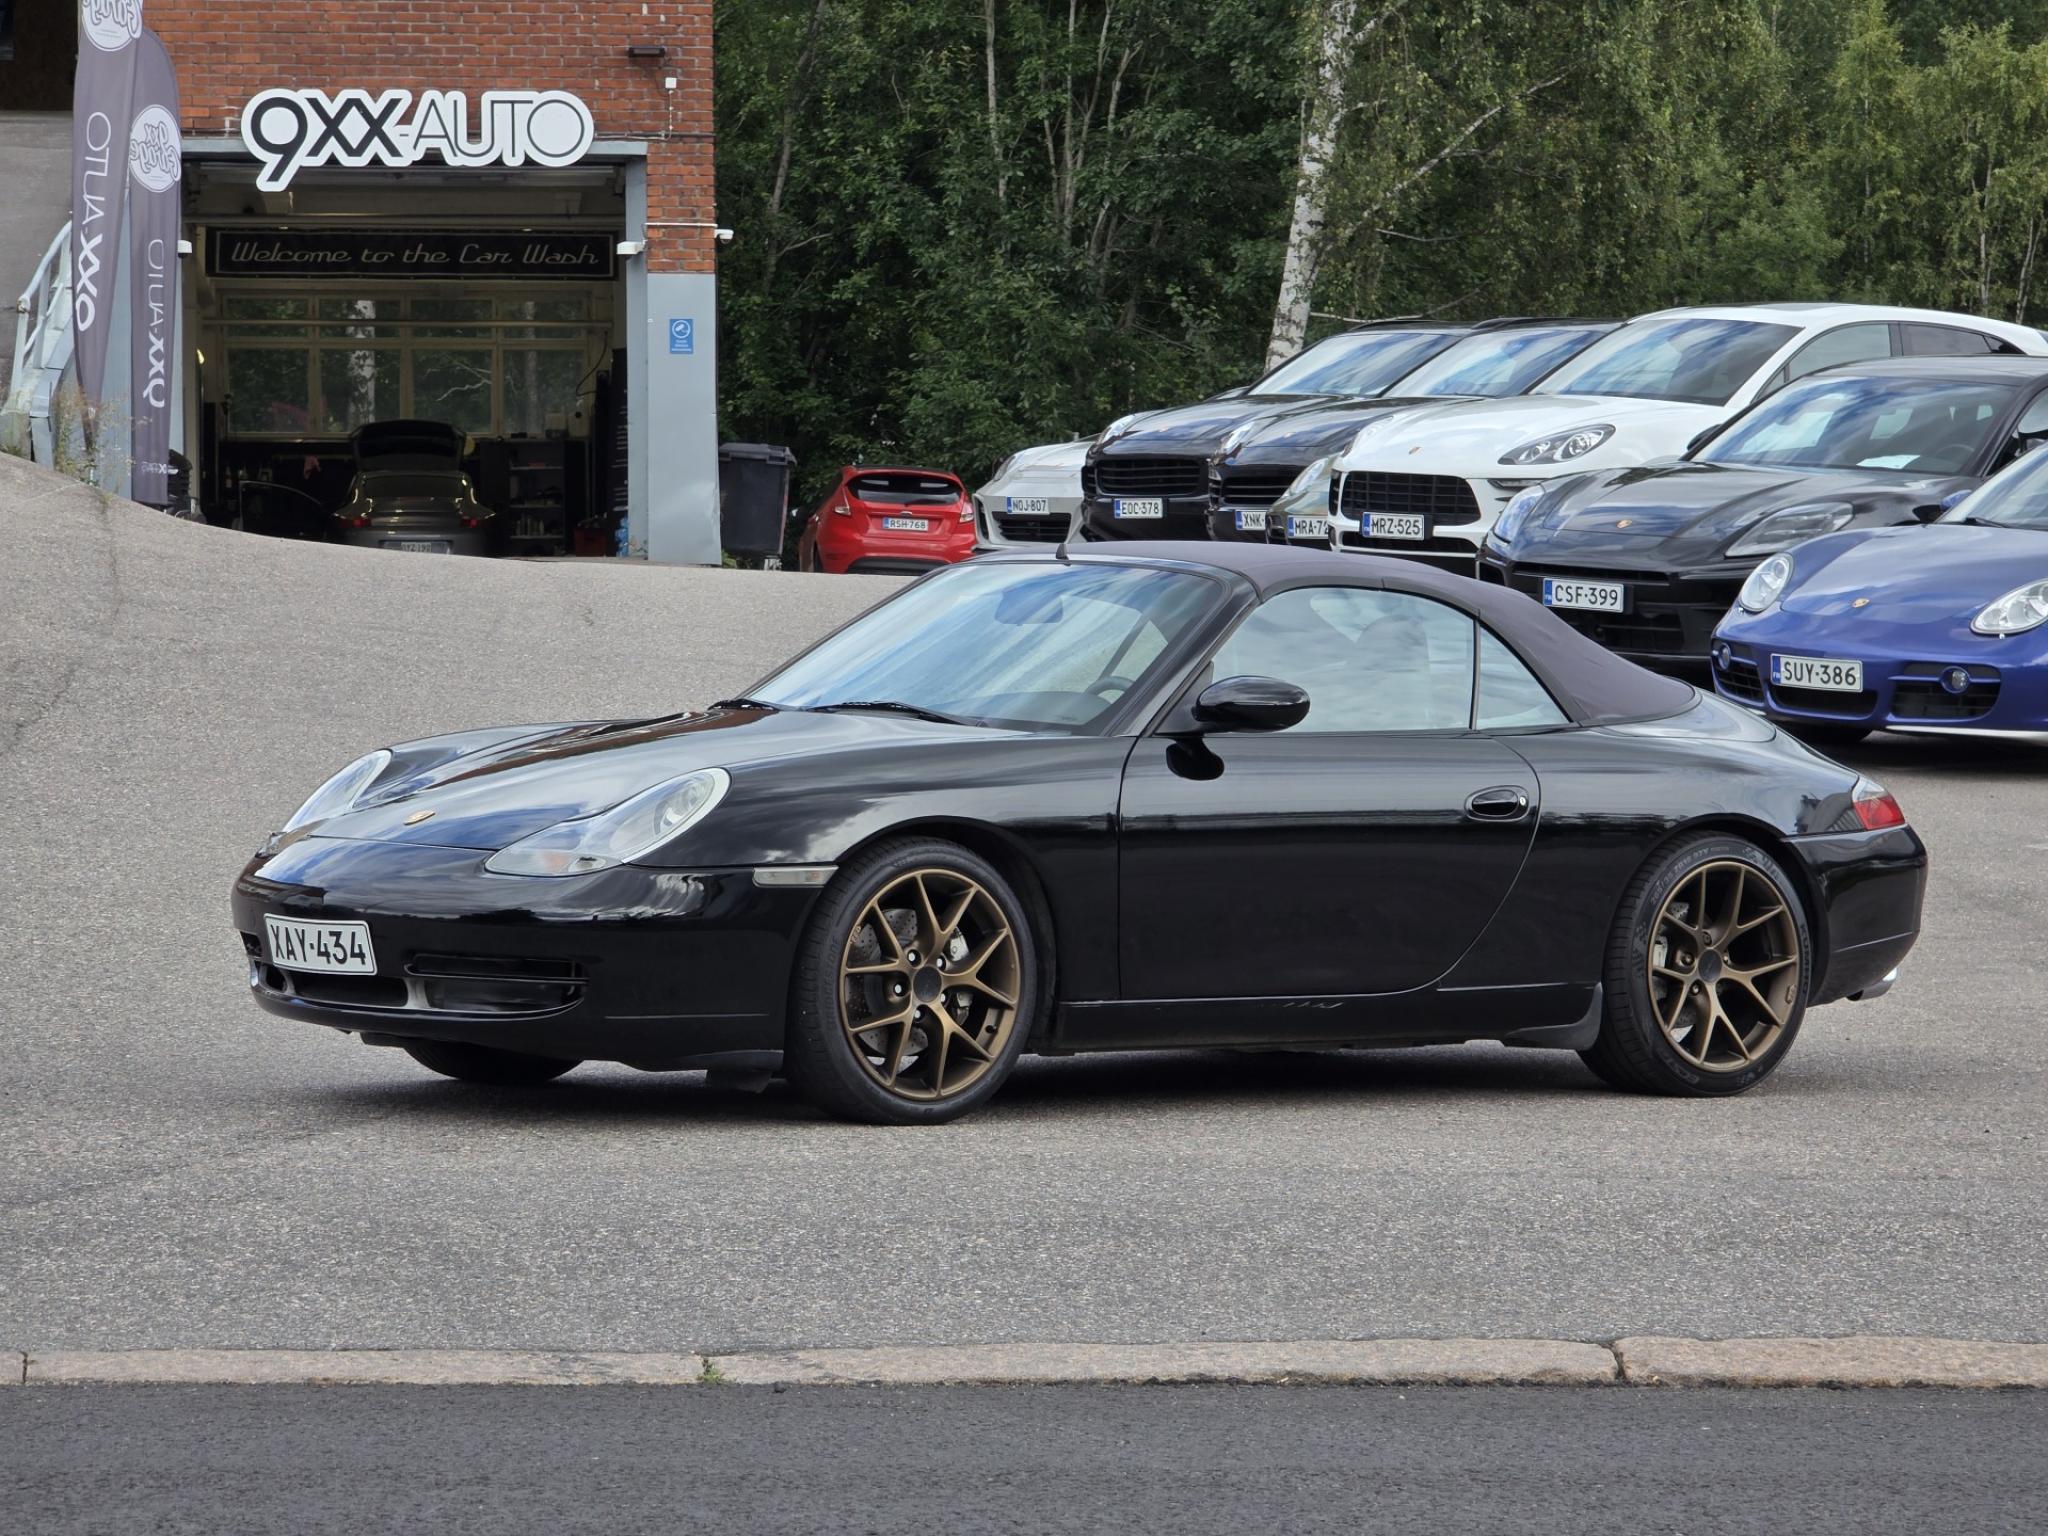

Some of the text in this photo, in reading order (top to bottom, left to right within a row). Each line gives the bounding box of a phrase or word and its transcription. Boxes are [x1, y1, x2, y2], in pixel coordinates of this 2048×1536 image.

[249, 95, 587, 184] 9XX-AUTO
[231, 242, 600, 264] Welcome to the Car Wash
[1012, 499, 1046, 512] NOJ-807
[1121, 502, 1160, 515] EOC-378
[890, 520, 926, 529] RSH-768
[1372, 517, 1421, 535] MRZ-525
[1555, 584, 1618, 606] CSF-399
[1784, 661, 1857, 686] SUY-386
[270, 924, 366, 966] XAY-434
